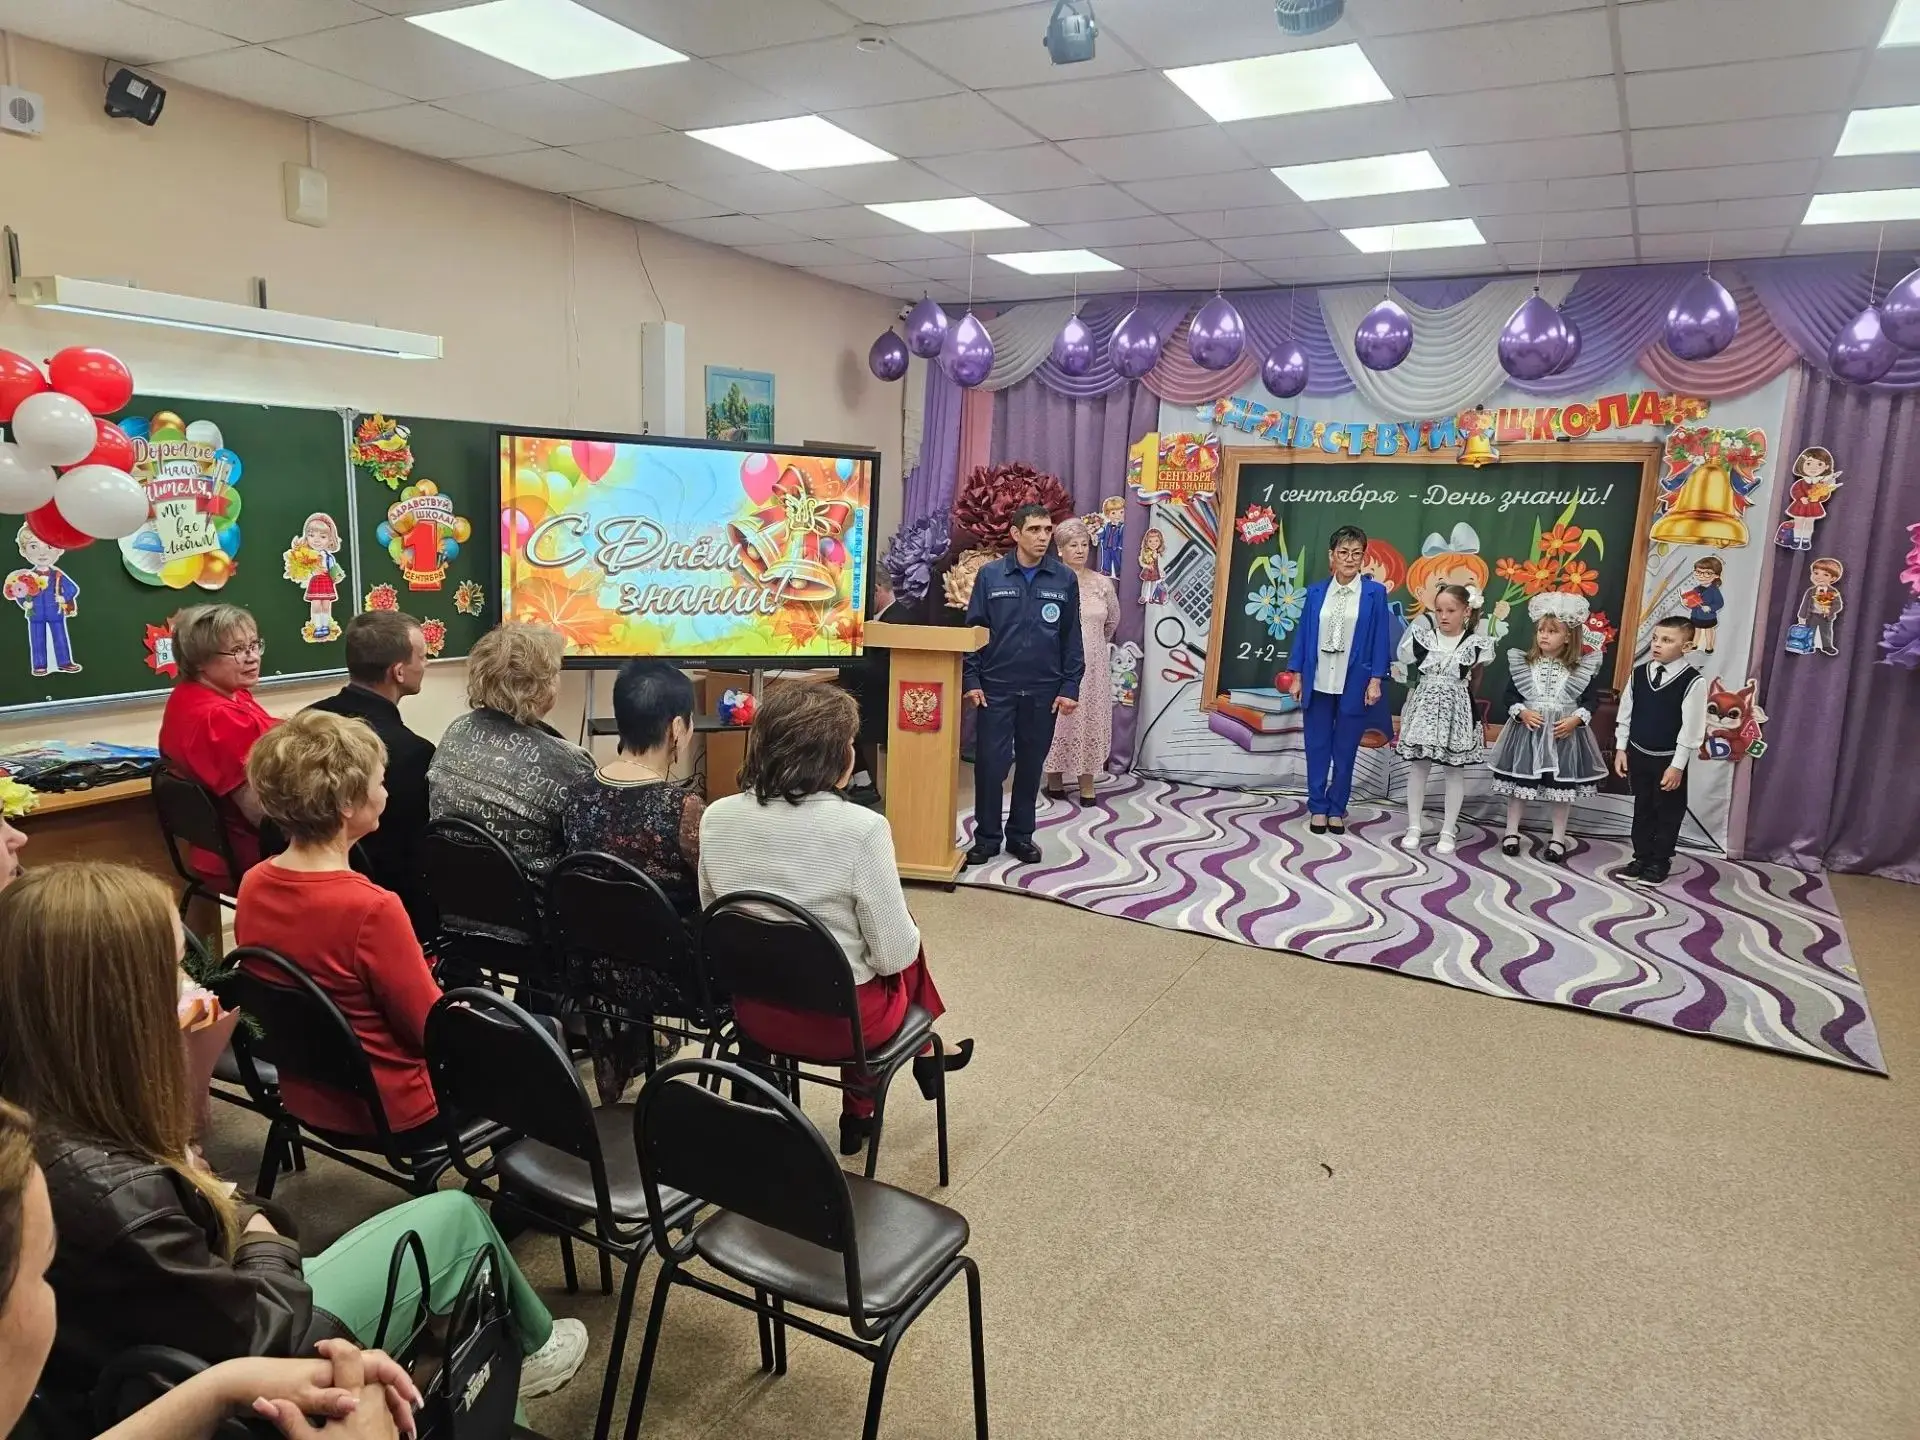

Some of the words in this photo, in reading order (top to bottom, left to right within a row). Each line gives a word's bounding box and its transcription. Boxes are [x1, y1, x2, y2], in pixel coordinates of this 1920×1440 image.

[132, 436, 213, 474] Дорогие
[1128, 431, 1160, 491] 1
[1157, 481, 1181, 491] ДЕНЬ
[1182, 480, 1217, 491] ЗНАНИЙ
[1158, 470, 1212, 482] СЕНТЯБРЯ
[145, 478, 212, 502] ителя,
[1263, 483, 1275, 502] 1
[1279, 482, 1399, 511] сентября
[1422, 484, 1495, 505] День
[1497, 483, 1615, 513] знаний!
[415, 510, 455, 526] ШКОЛА!
[403, 520, 441, 591] 1
[525, 511, 590, 569] С
[596, 514, 744, 575] Днём
[404, 571, 445, 582] СЕНТЯБРЯ
